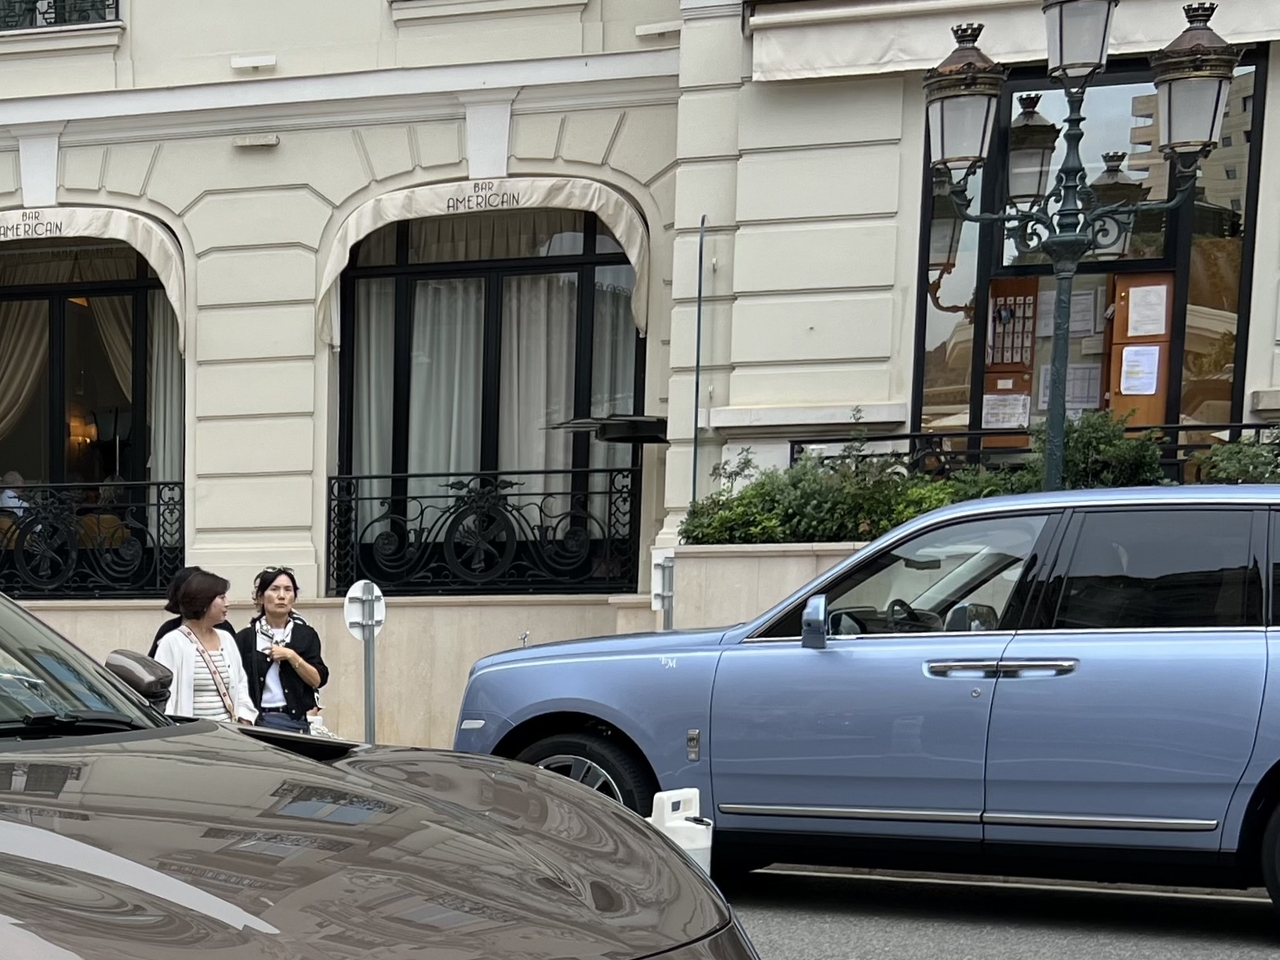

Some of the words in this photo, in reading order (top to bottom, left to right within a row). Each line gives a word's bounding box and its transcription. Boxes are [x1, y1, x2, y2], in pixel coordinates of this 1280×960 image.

[473, 181, 494, 194] BAR
[446, 192, 520, 212] AMERICAIN
[21, 211, 40, 222] BAR
